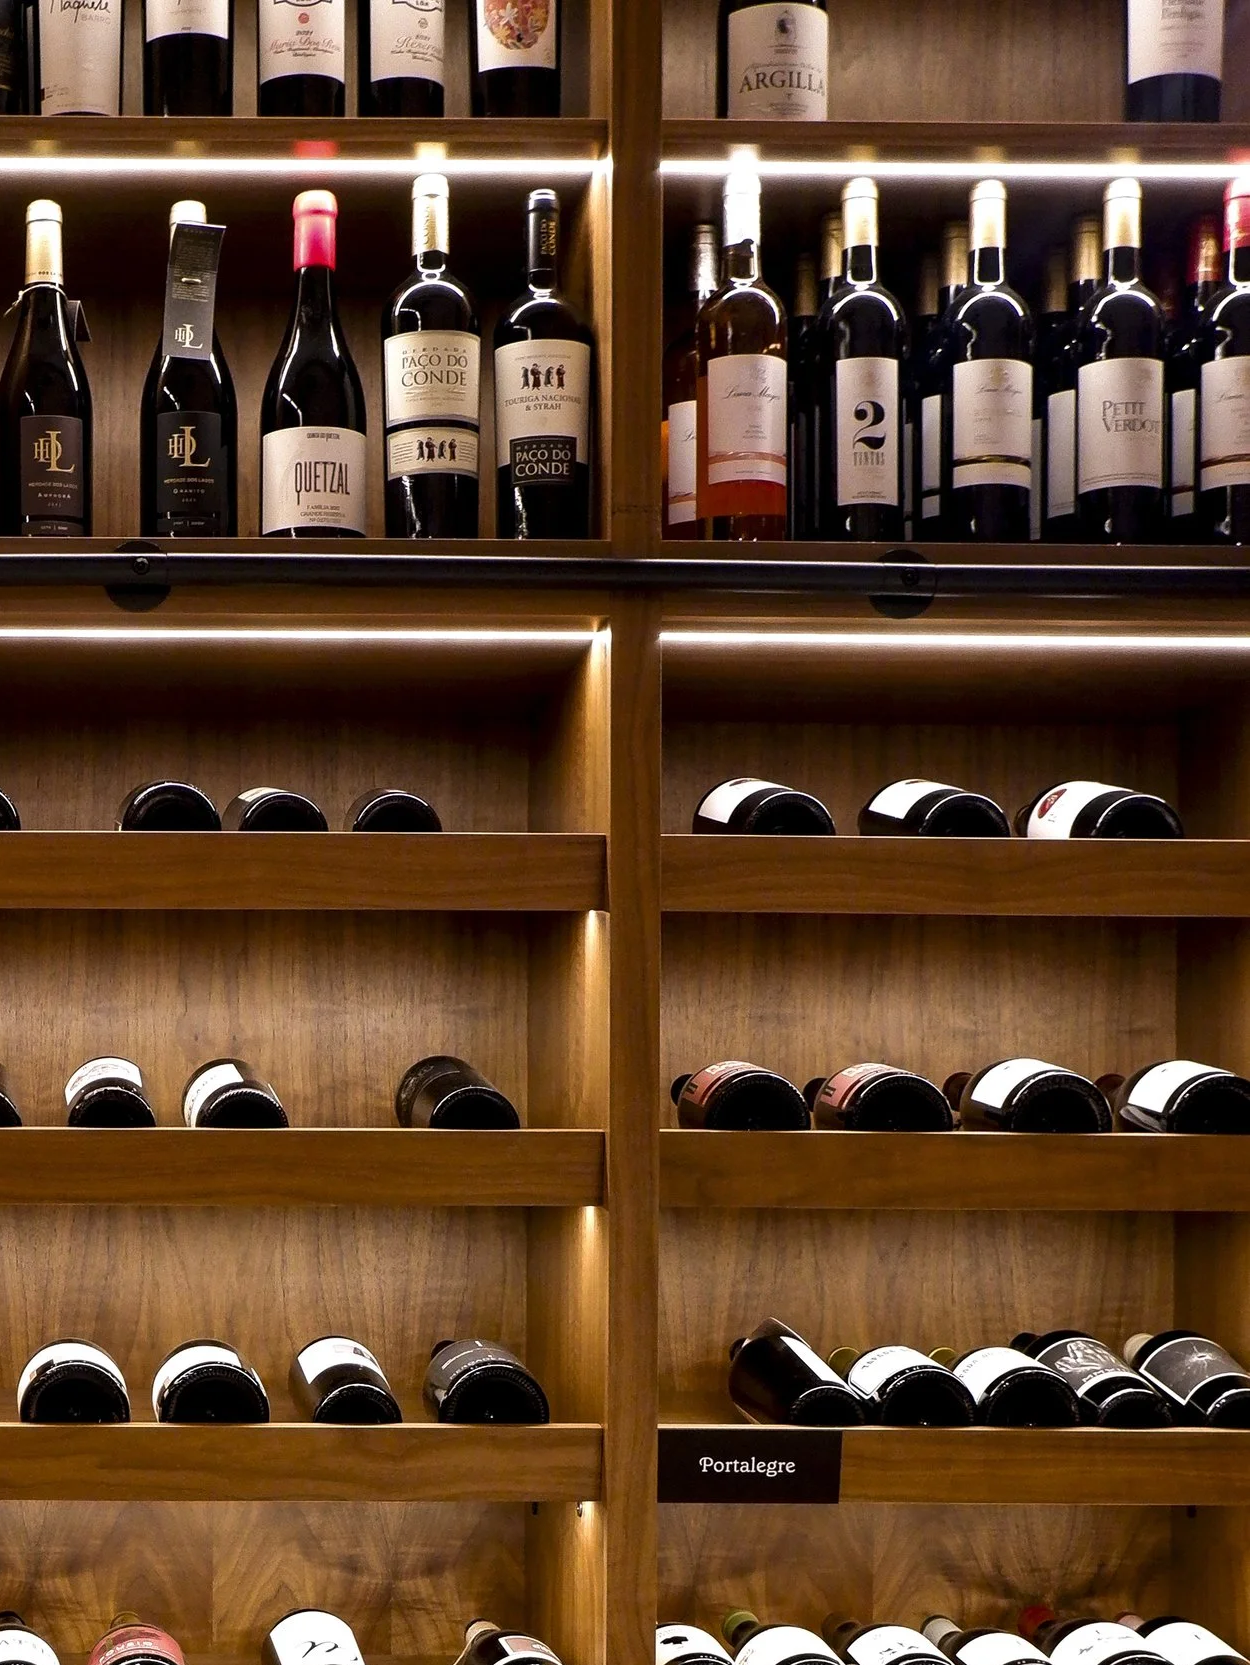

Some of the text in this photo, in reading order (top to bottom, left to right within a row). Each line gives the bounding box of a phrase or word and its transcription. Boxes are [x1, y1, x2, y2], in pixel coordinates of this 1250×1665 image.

[402, 354, 469, 370] PAÇO DO
[401, 370, 468, 387] CONDE
[504, 396, 538, 408] TOURIGA
[533, 403, 562, 412] SYRAH
[852, 400, 886, 450] 2
[515, 450, 571, 463] PAÇO DO
[515, 462, 570, 478] CONDE
[294, 462, 351, 506] QUETZAL
[699, 1456, 796, 1478] Portalegre
